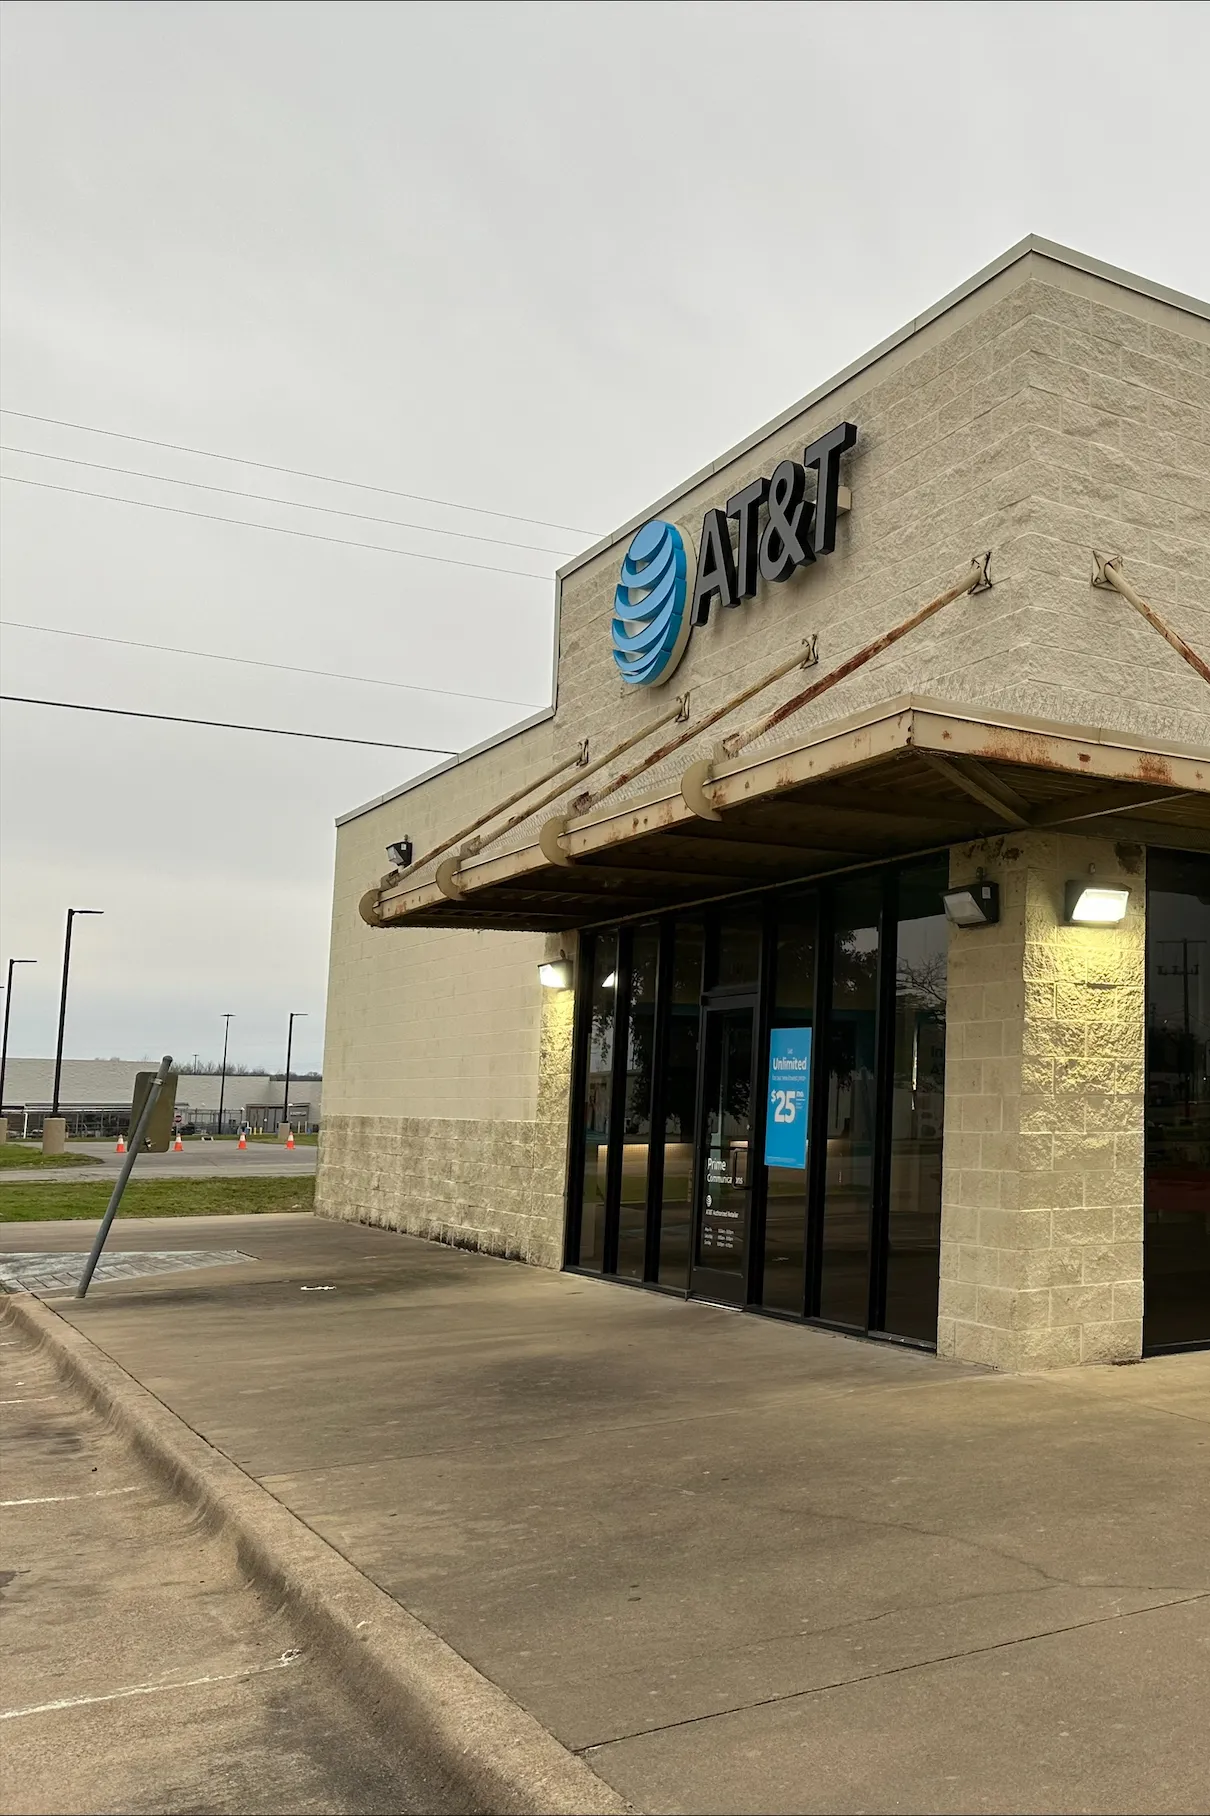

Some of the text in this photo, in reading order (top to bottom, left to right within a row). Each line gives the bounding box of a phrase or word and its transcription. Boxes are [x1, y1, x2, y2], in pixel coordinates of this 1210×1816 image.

[690, 421, 857, 627] AT&T
[772, 1056, 807, 1071] Unlimited
[707, 1157, 727, 1171] Prime
[706, 1173, 743, 1185] Communicans
